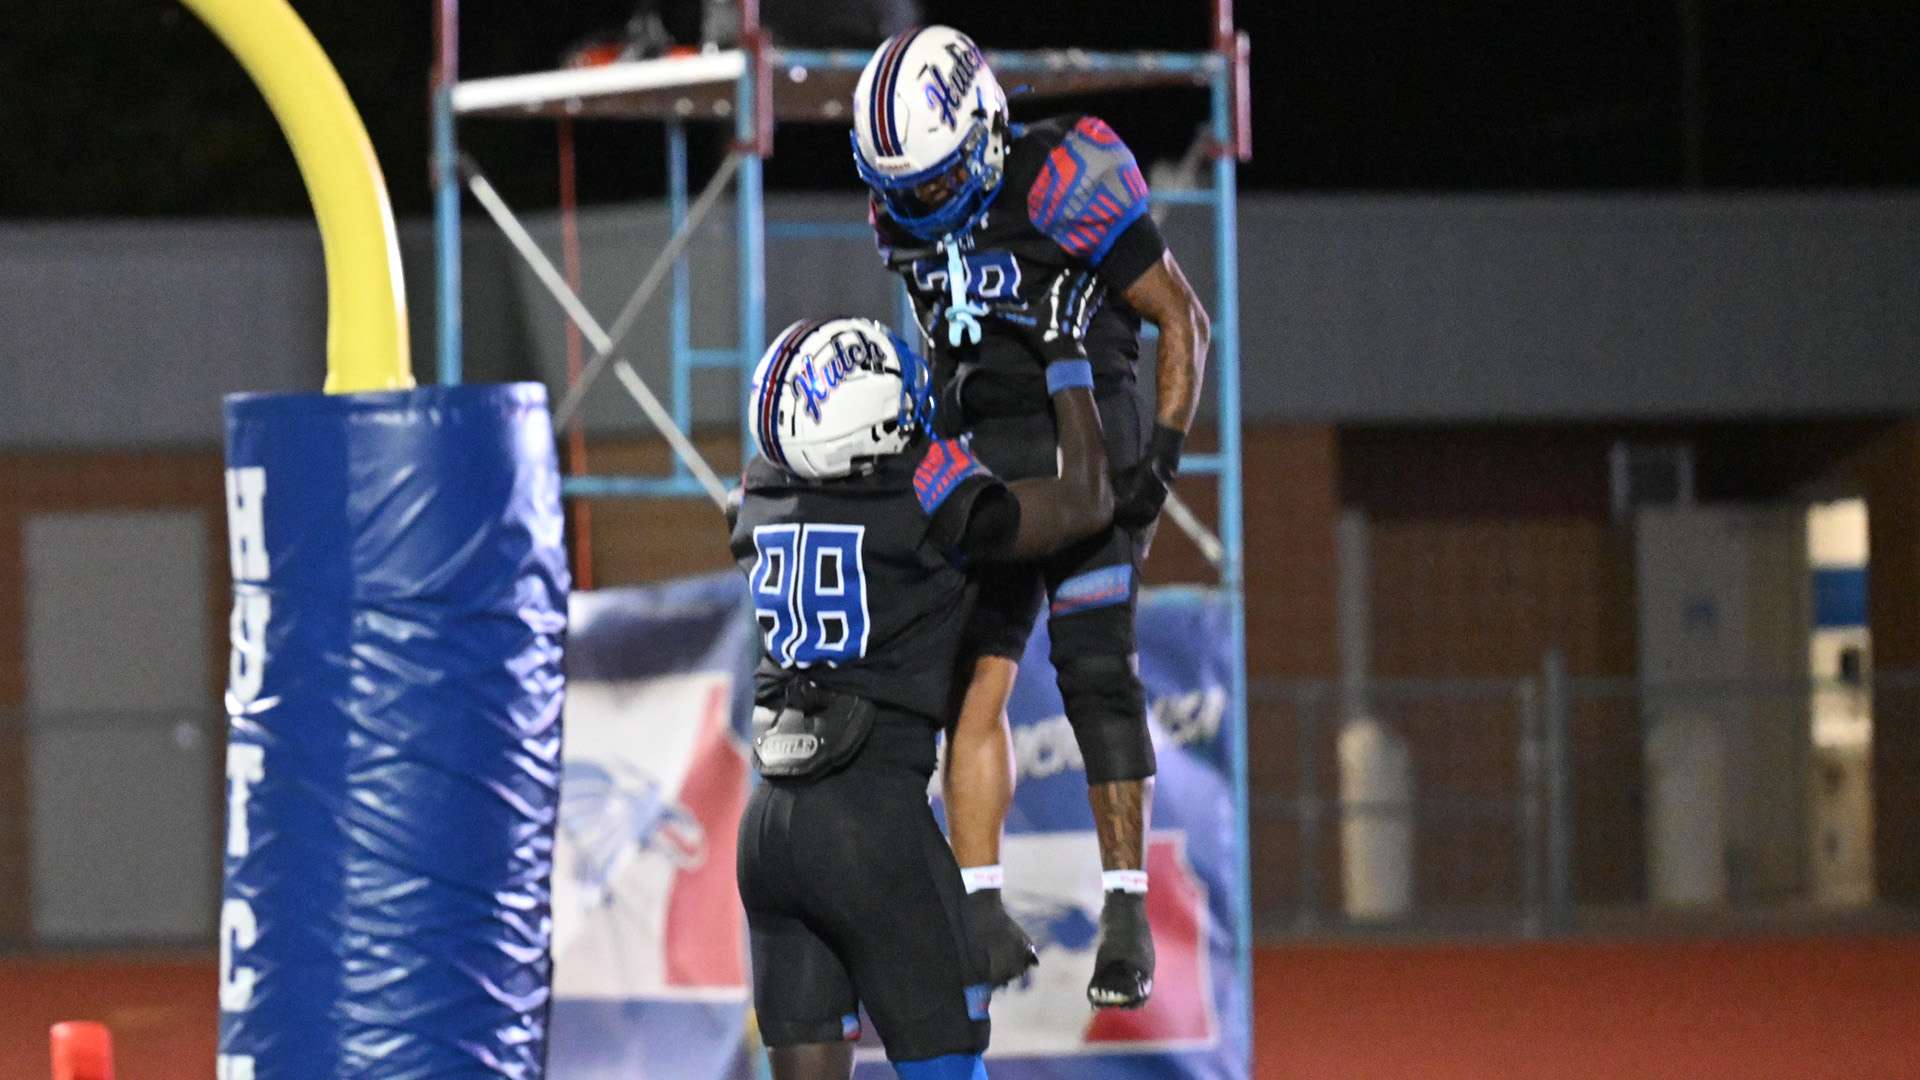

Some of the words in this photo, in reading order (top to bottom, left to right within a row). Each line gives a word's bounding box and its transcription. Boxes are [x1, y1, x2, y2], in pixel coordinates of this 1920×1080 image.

[791, 329, 888, 423] Hutch
[750, 523, 870, 668] 98
[217, 466, 271, 1080] HUTC
